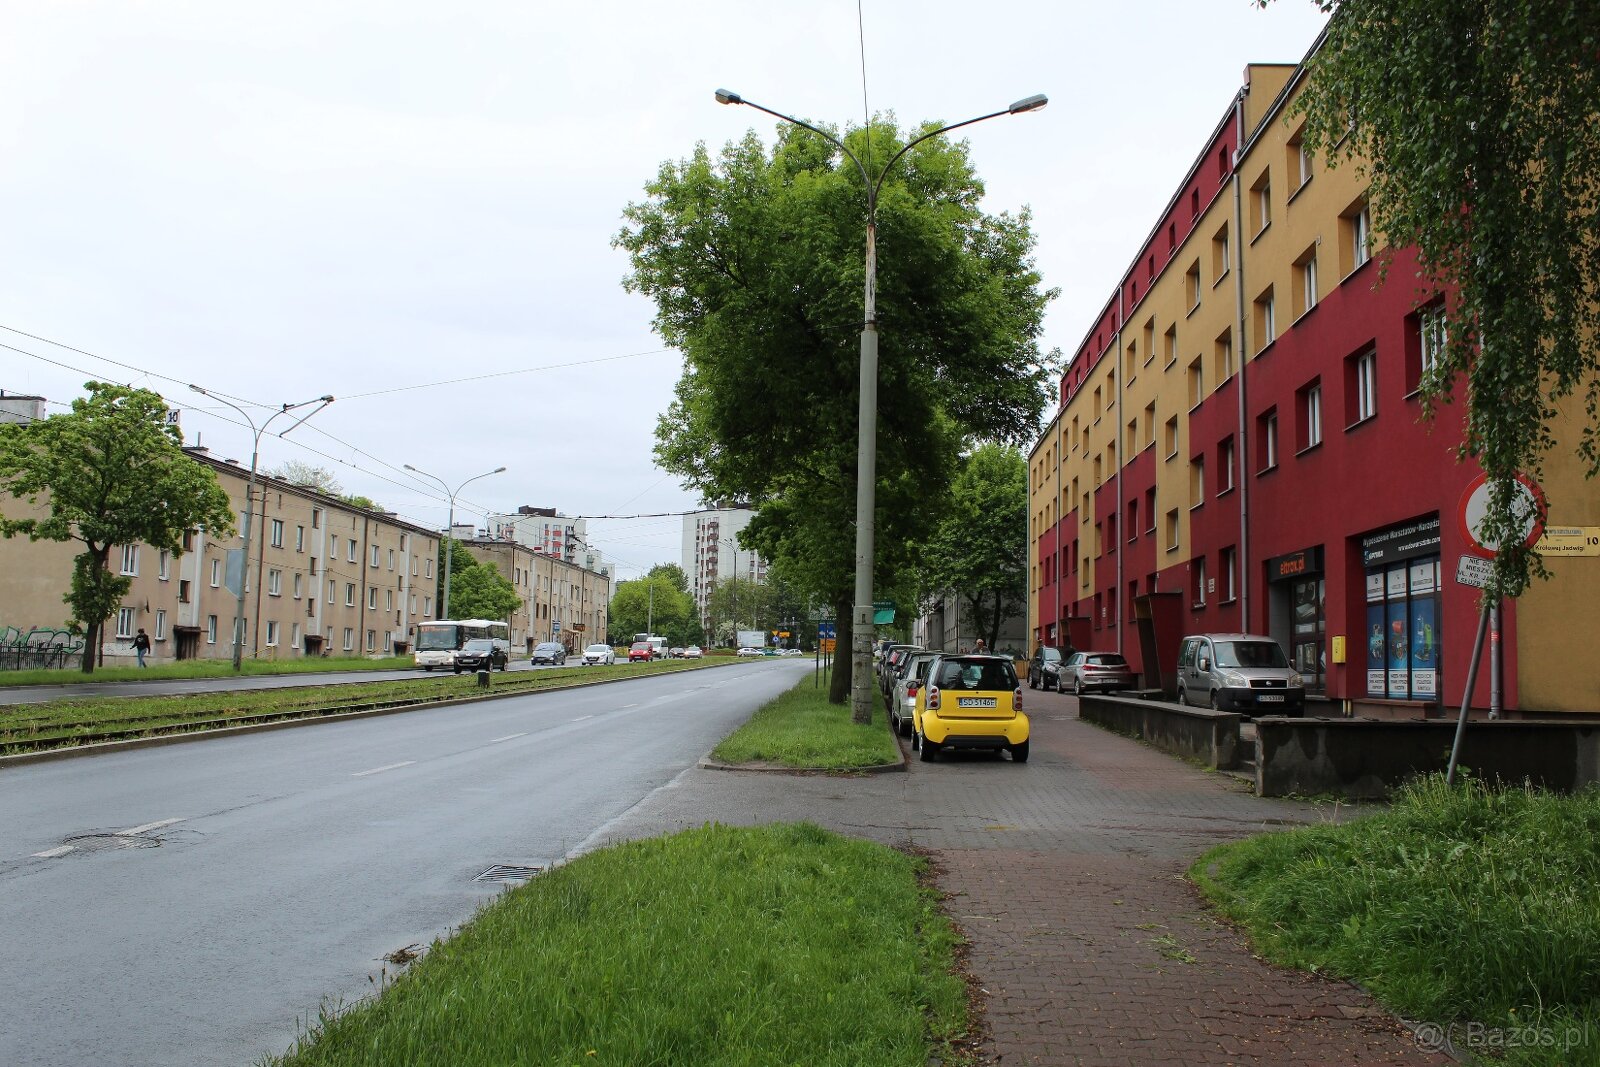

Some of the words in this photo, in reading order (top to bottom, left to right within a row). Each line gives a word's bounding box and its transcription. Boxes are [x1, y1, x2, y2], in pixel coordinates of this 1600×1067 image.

[168, 412, 178, 422] 10
[1586, 536, 1599, 545] 10
[1535, 544, 1561, 552] Królowej
[1468, 558, 1480, 566] NIE
[1466, 564, 1494, 576] MIESZKA
